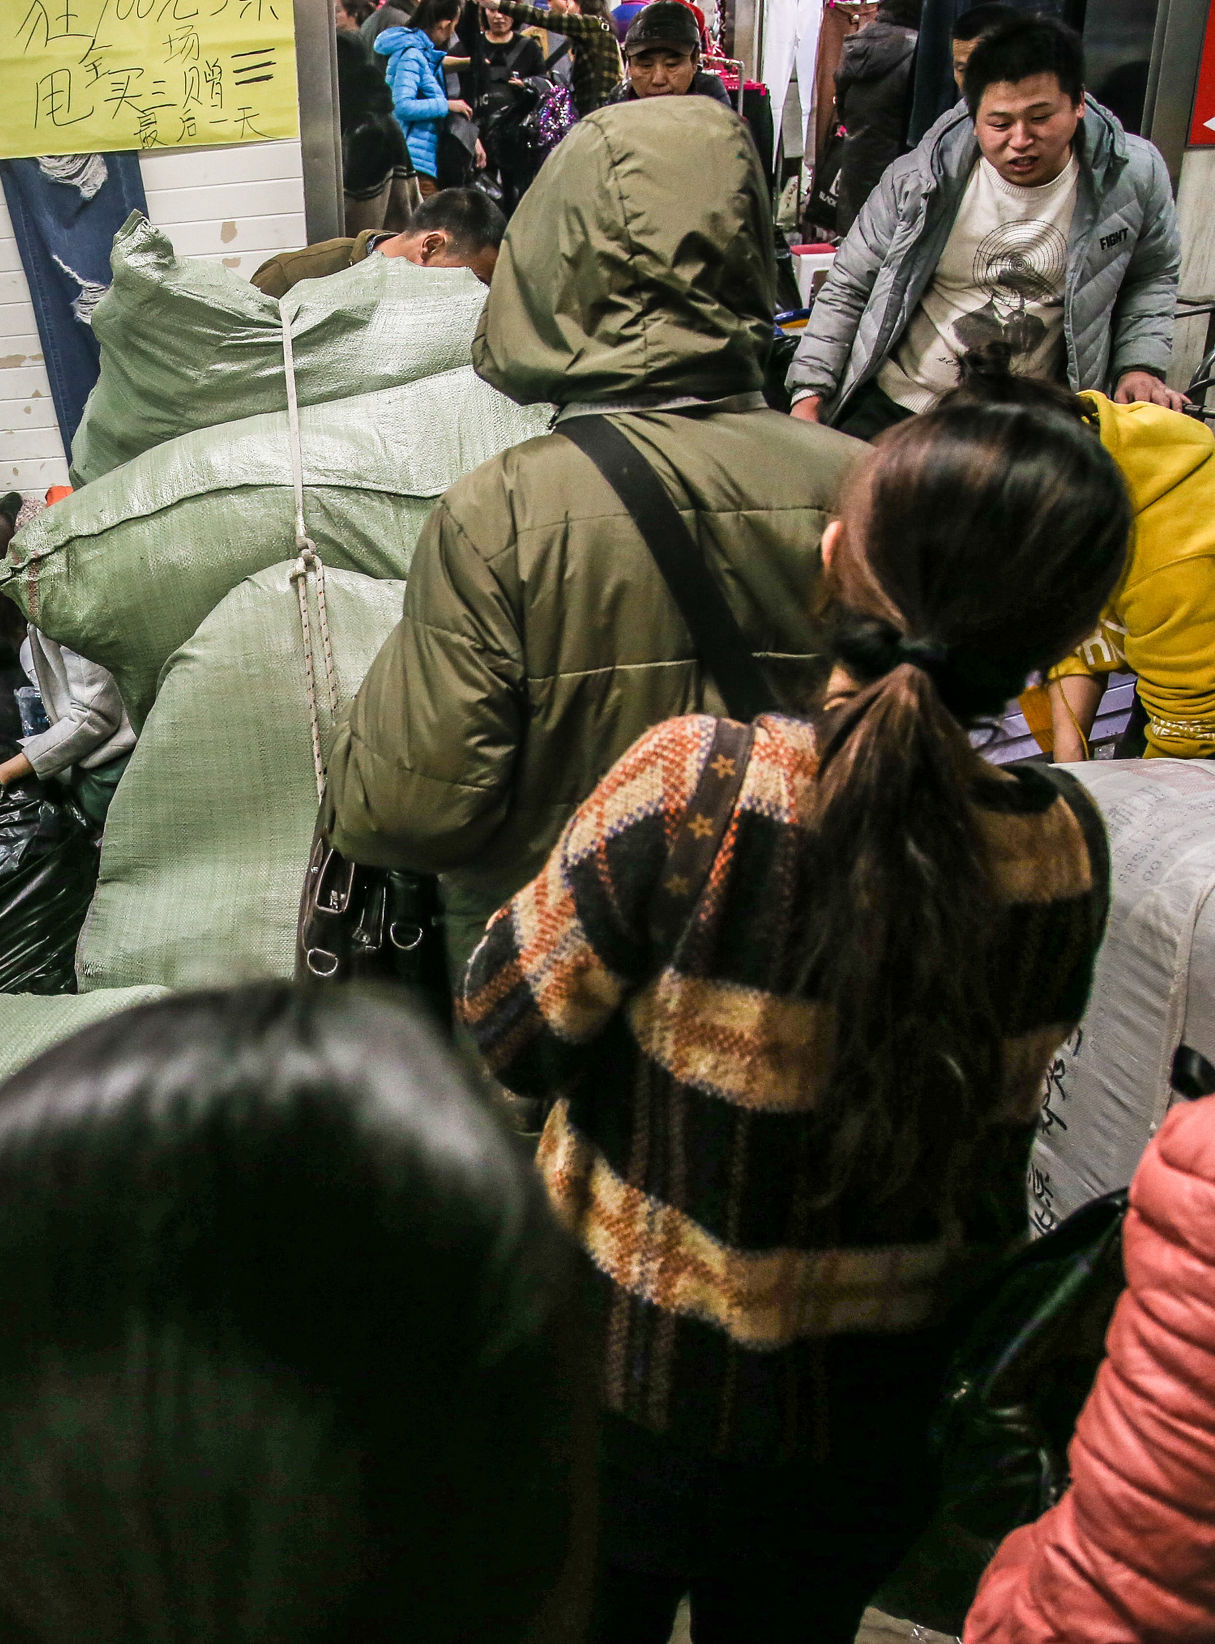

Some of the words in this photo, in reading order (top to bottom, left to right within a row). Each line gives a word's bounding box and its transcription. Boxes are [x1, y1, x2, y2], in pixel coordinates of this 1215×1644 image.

[133, 106, 275, 149] 最后一天
[1099, 227, 1129, 251] FIGHT
